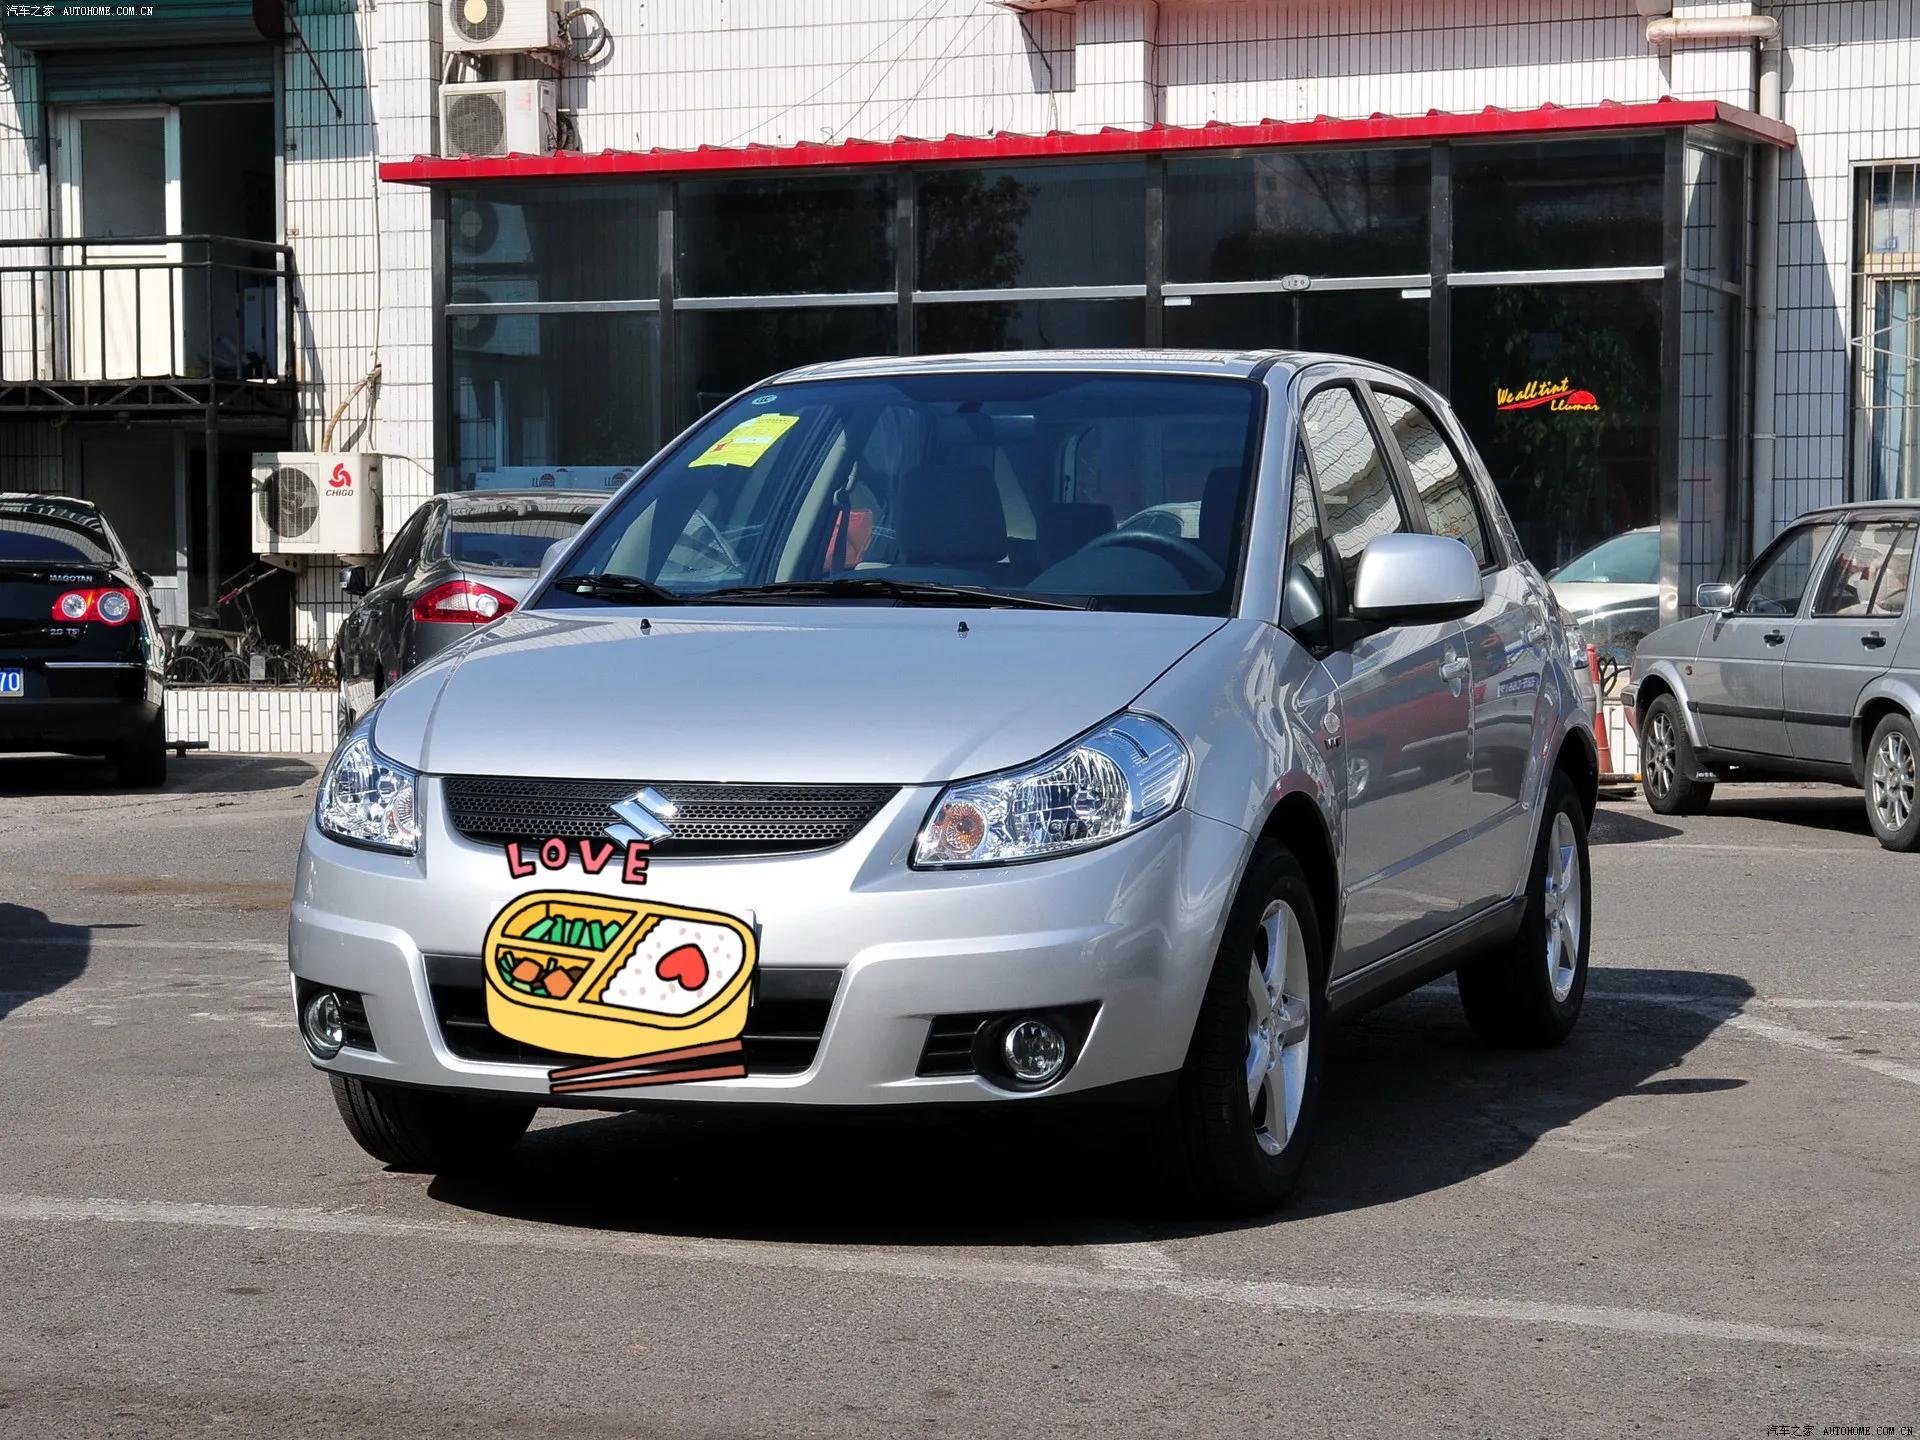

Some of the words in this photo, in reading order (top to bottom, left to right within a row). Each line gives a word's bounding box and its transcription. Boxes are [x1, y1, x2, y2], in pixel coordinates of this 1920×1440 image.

[1497, 388, 1514, 406] We
[1515, 380, 1538, 401] all
[1538, 377, 1569, 397] tint
[325, 489, 354, 497] CHIGO
[49, 574, 93, 582] MAGOTAN
